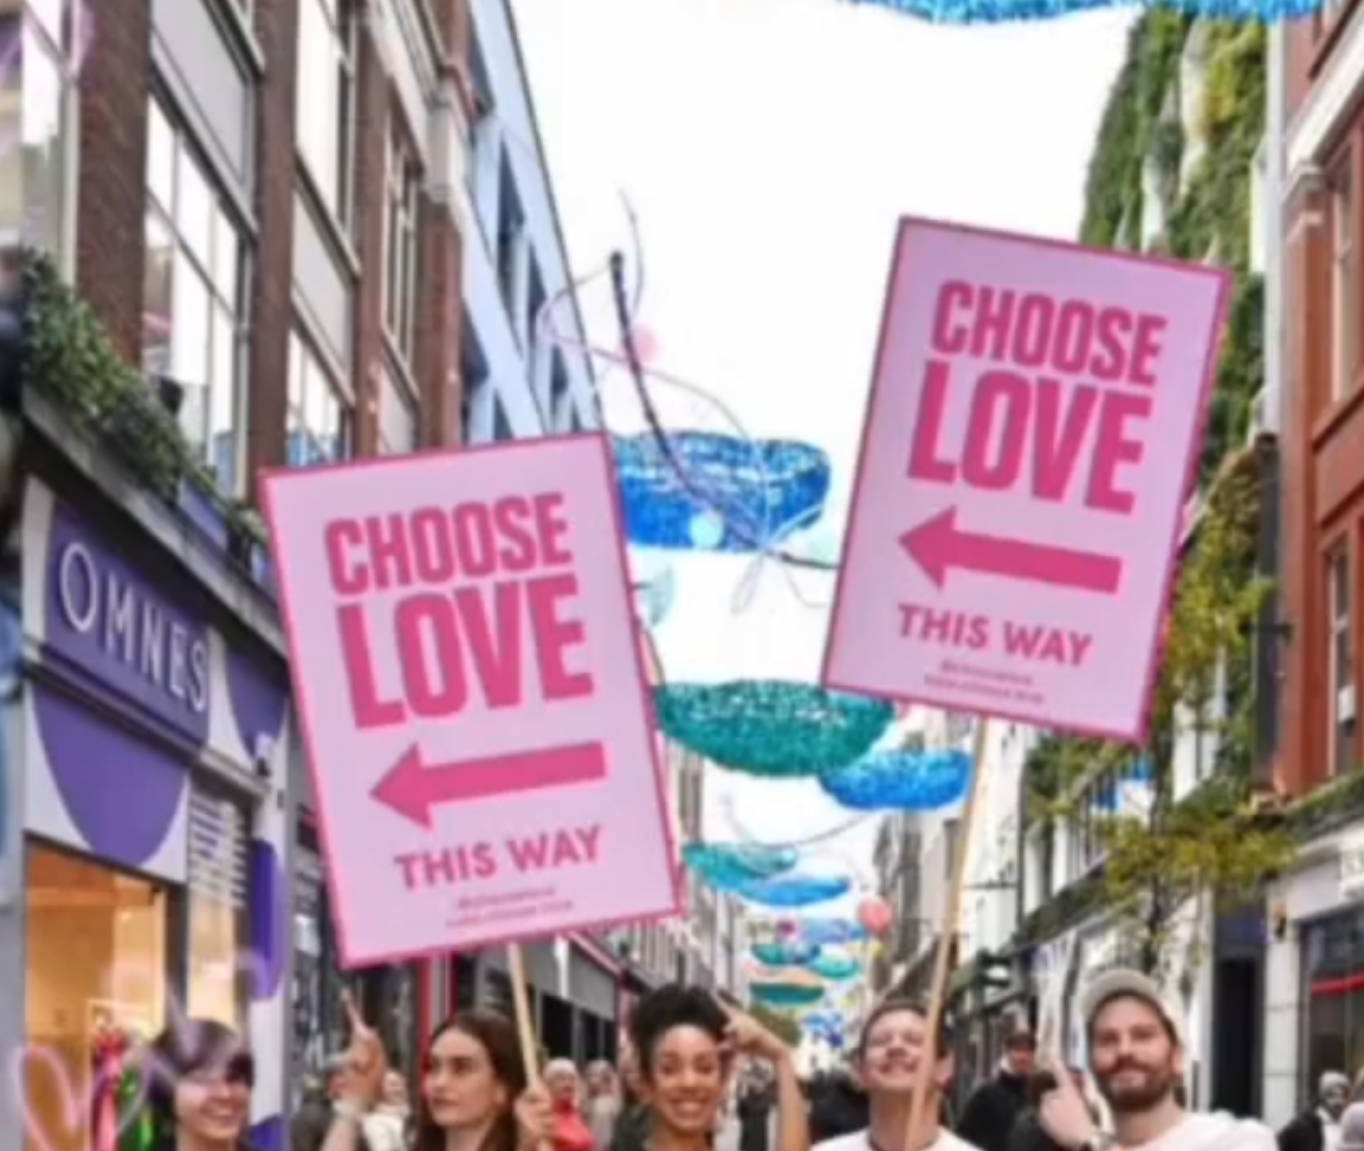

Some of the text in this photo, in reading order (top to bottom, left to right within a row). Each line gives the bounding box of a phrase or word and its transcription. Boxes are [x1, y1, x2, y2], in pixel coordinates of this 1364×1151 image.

[930, 280, 1167, 387] CHOOSE
[907, 359, 1154, 515] LOVE
[325, 493, 572, 595] CHOOSE
[60, 542, 209, 713] OMNES
[336, 573, 594, 730] LOVE
[897, 602, 1093, 667] THIS WAY
[393, 824, 601, 891] THIS WAY
